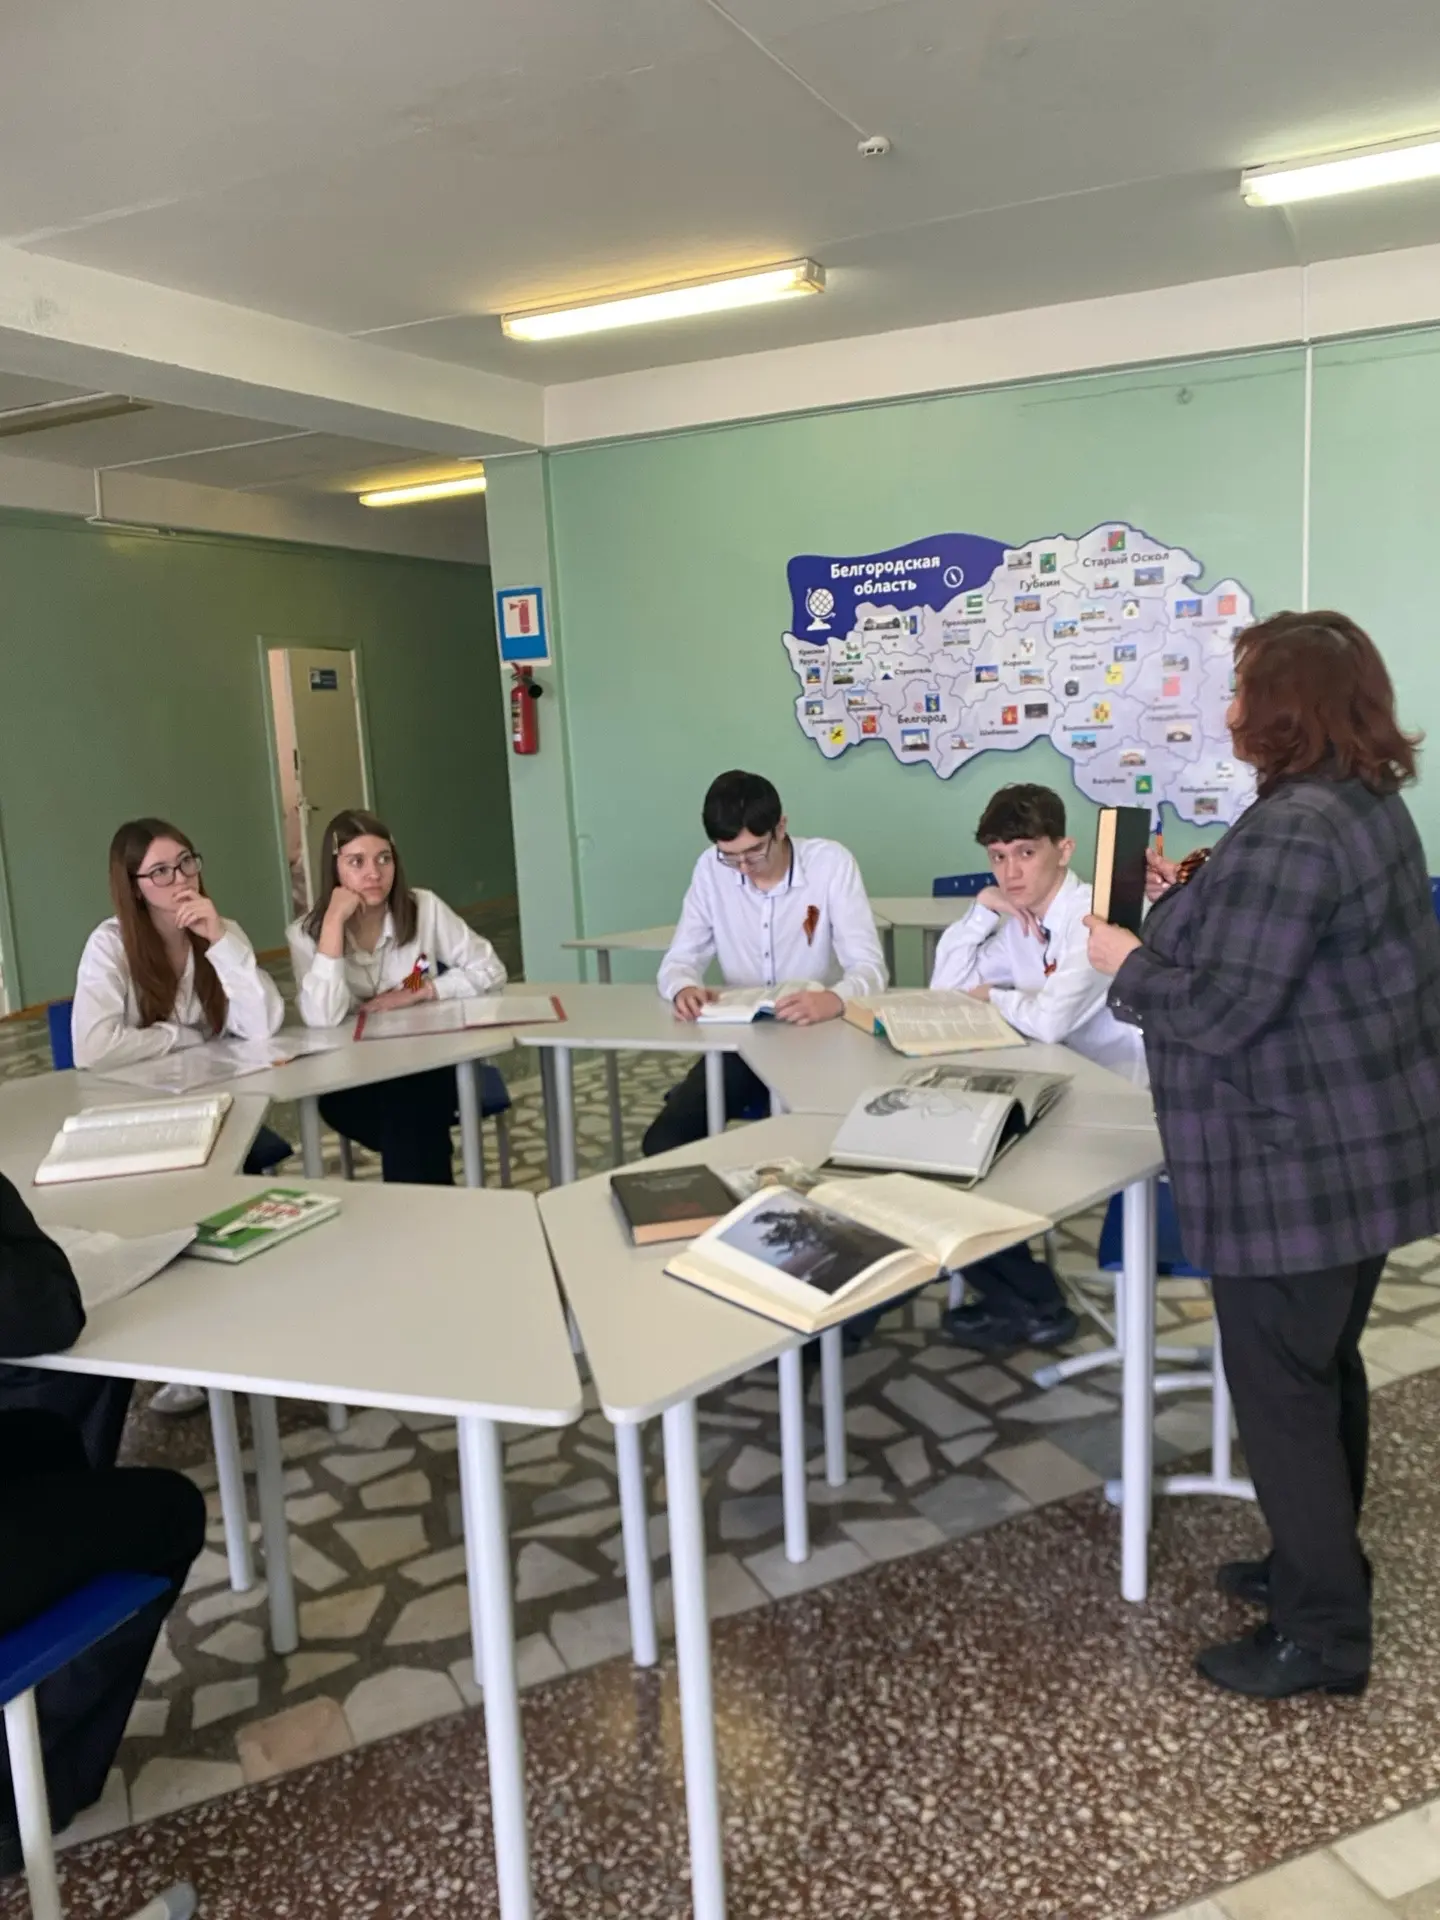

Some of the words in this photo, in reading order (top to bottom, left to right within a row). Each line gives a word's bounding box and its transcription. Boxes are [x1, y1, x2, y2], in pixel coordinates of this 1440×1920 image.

[830, 555, 941, 580] Белгородская
[1082, 552, 1128, 568] Старый
[1130, 551, 1170, 563] Оскол
[853, 579, 917, 596] область
[1019, 578, 1061, 592] Губкин
[897, 713, 947, 726] Белгород
